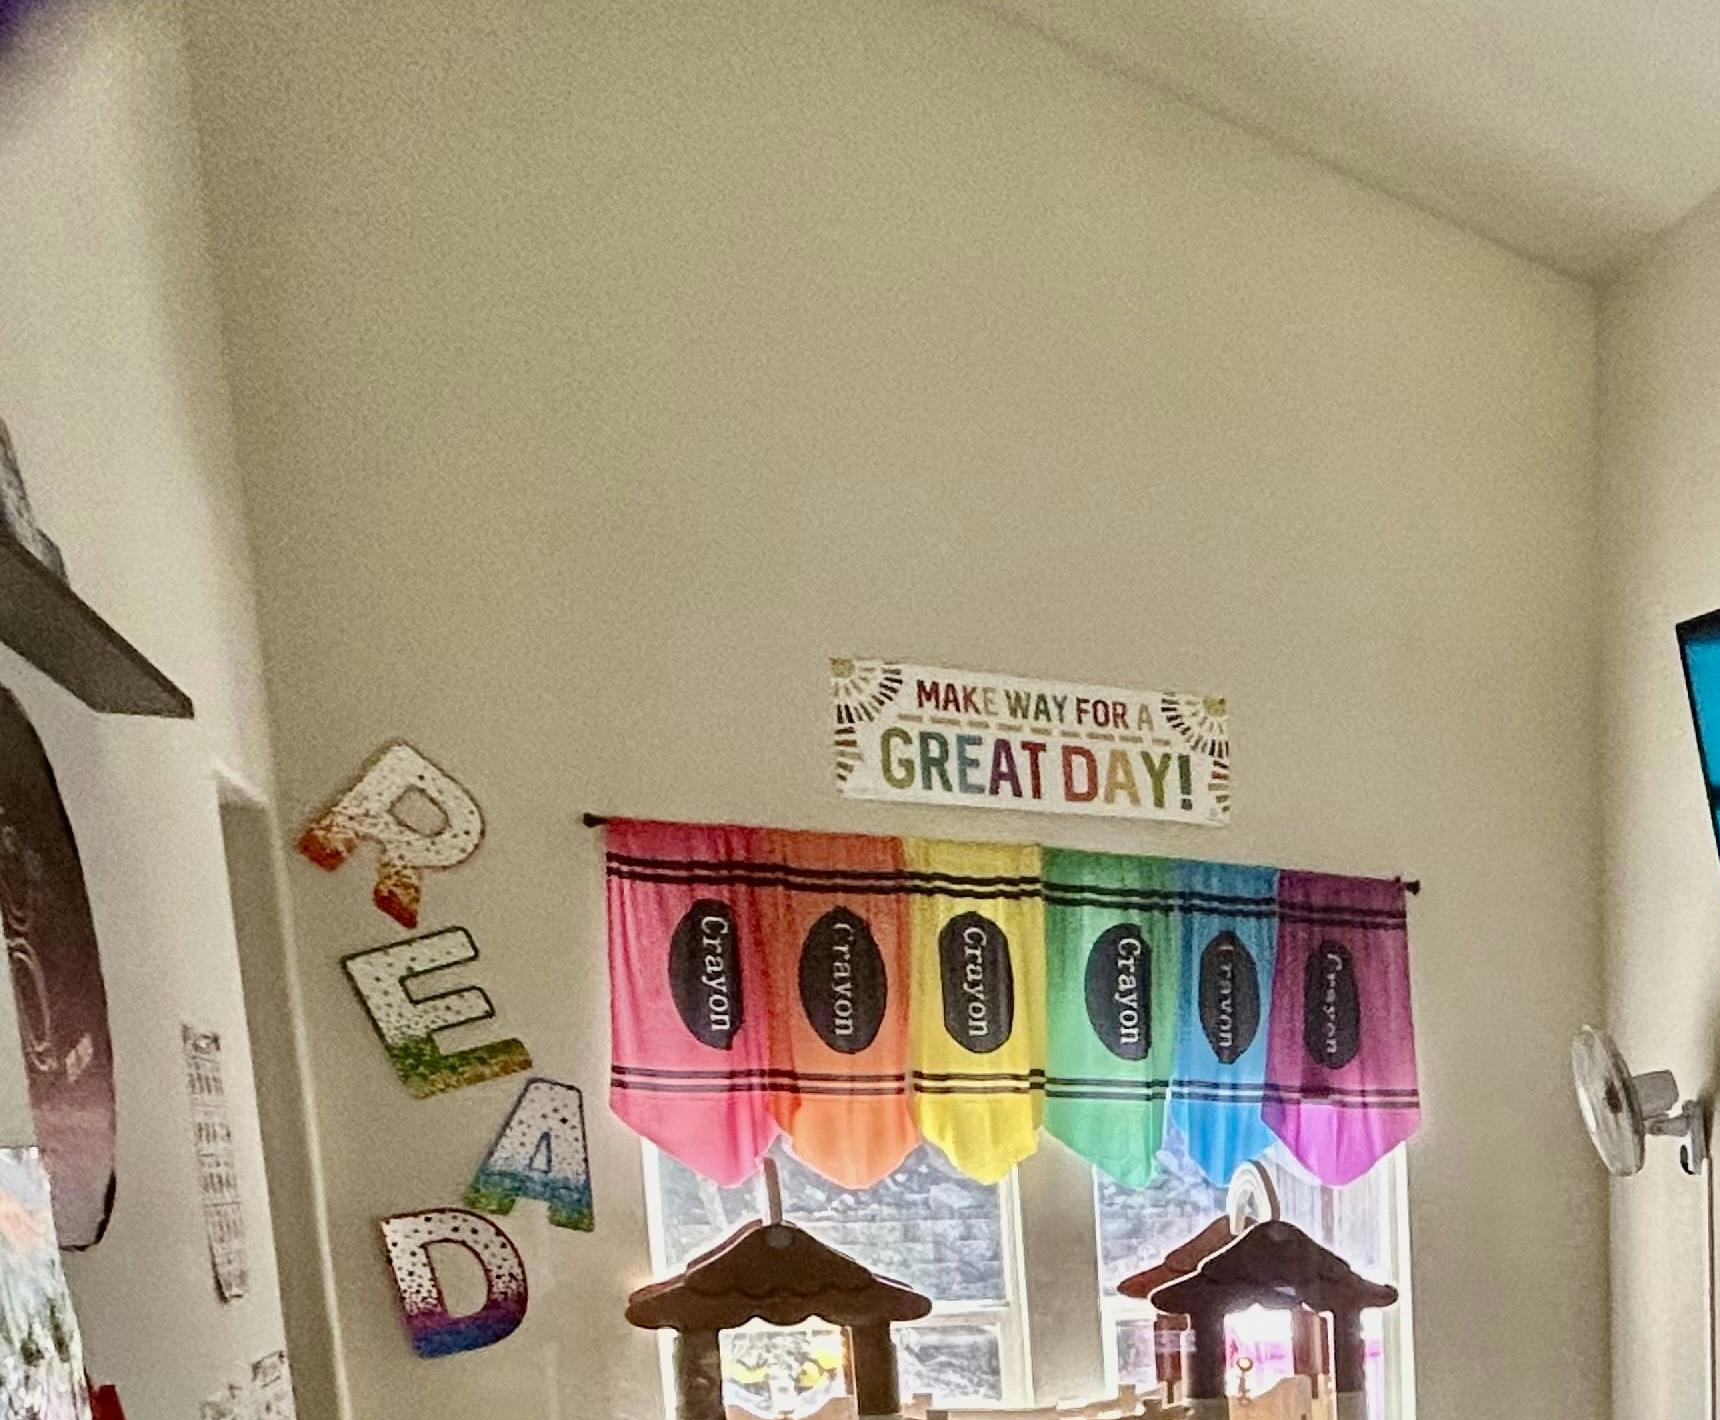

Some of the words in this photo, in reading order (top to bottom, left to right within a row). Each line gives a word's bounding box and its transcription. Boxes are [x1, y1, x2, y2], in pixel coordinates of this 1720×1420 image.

[916, 680, 998, 717] MAKE
[1004, 688, 1069, 723] WAY
[1075, 696, 1129, 730] FOR
[1137, 702, 1155, 731] A
[879, 726, 1048, 801] GREAT
[1061, 744, 1193, 811] DAY!
[701, 915, 732, 1032] Crayon
[962, 926, 989, 1037] Crayon
[1114, 937, 1142, 1044] Crayon
